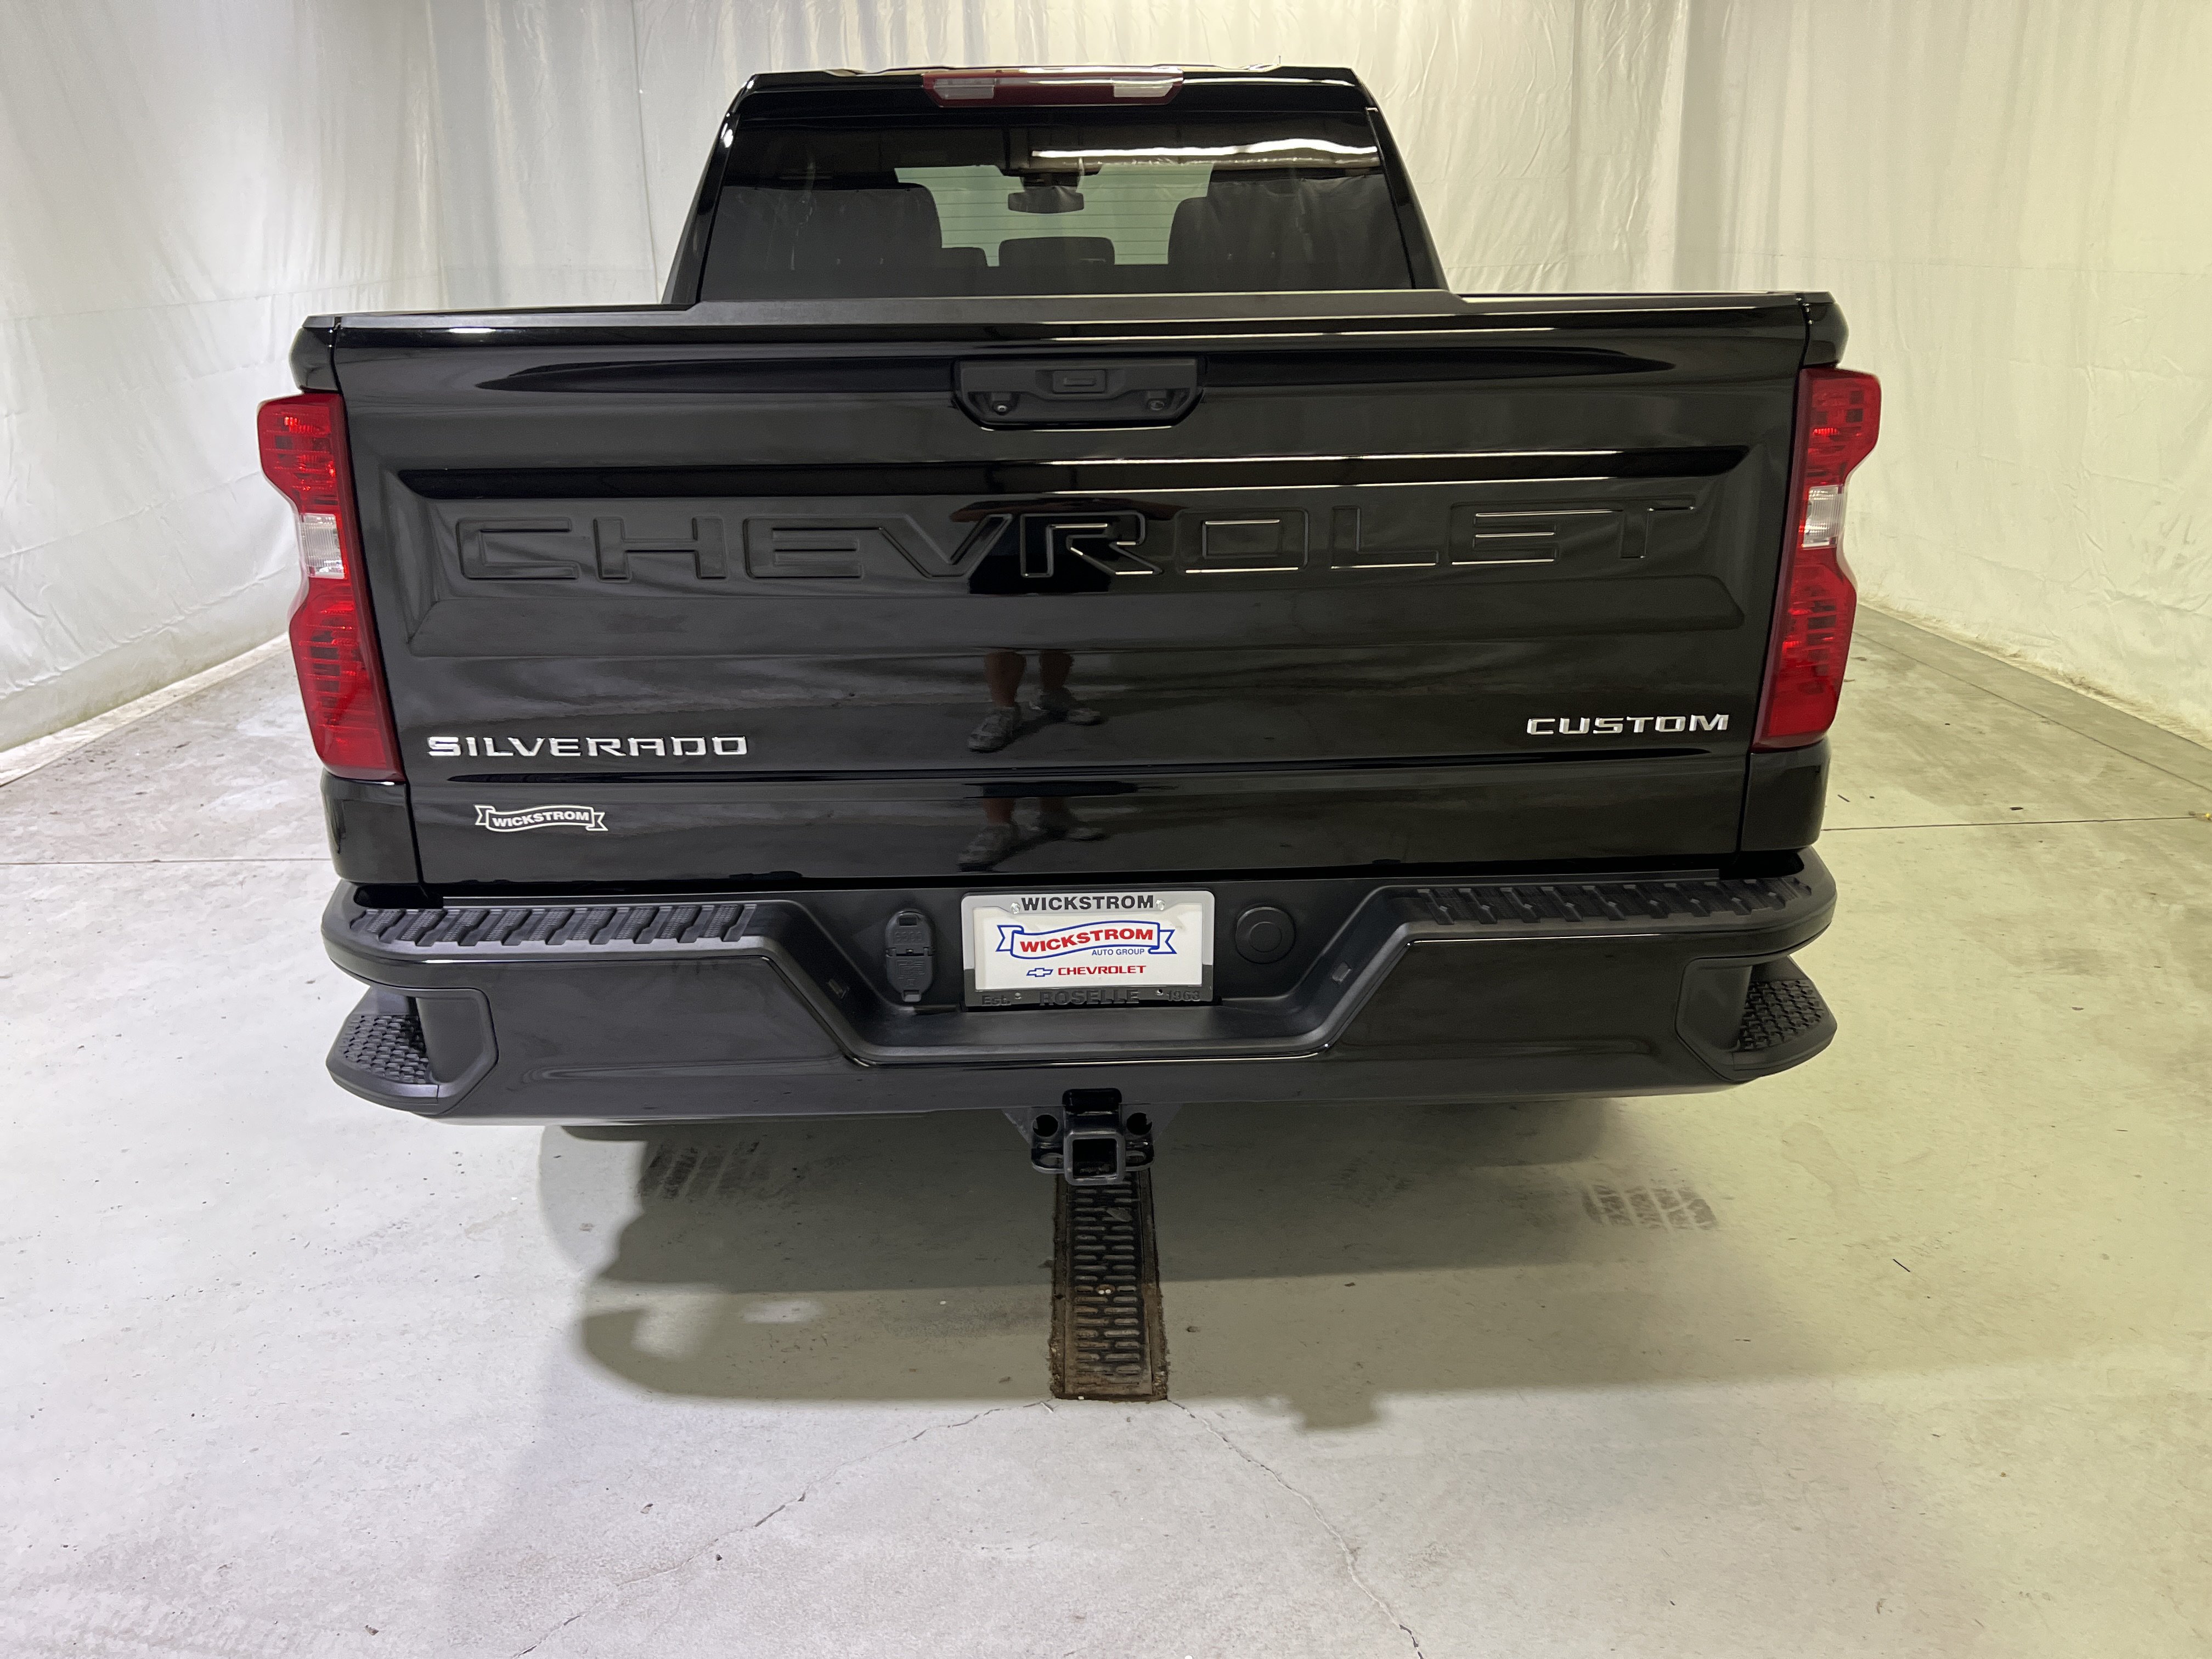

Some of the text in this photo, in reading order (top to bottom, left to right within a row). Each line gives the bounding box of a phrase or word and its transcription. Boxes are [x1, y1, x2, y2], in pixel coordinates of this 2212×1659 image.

[456, 496, 1696, 580] CHEVROLET
[1526, 714, 1729, 735] CUSTOM
[427, 736, 748, 757] SILVERADO
[492, 811, 590, 827] WICKSTROM
[1021, 895, 1153, 911] WICKSTROM
[1020, 929, 1153, 952] WICKSTROM
[1058, 966, 1147, 975] CHEVROLET
[981, 995, 1011, 1006] Est.
[1039, 989, 1139, 1006] ROSELLE
